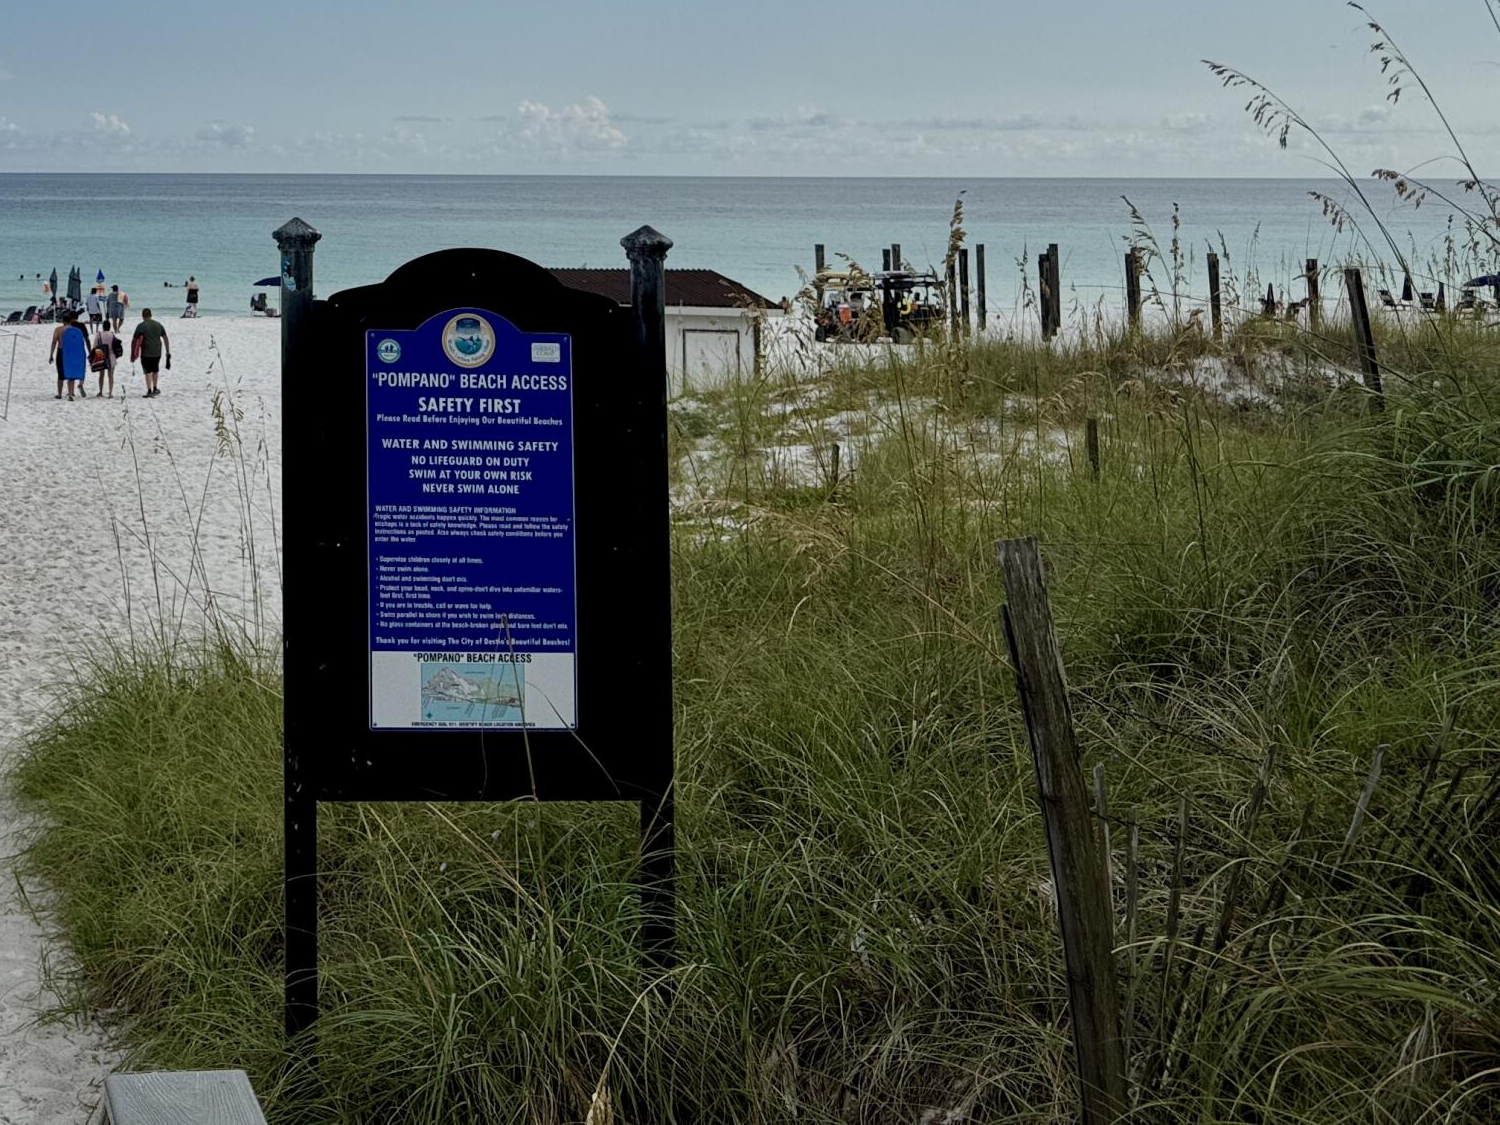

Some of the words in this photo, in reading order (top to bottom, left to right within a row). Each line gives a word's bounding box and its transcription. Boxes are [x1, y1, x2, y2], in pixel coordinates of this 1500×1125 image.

[373, 372, 455, 388] "POMPANO"
[460, 374, 507, 389] BEACH
[511, 375, 567, 390] ACCESS
[418, 397, 473, 412] SAFETY
[480, 398, 521, 413] FIRST
[377, 414, 401, 423] Please
[403, 414, 421, 423] Read
[423, 415, 447, 424] Before
[449, 416, 480, 426] Enjoying
[482, 416, 495, 424] Our
[497, 416, 532, 425] Beautiful
[534, 417, 563, 426] Beaches
[382, 438, 420, 449] WATER
[423, 439, 448, 450] AND
[451, 439, 514, 451] SWIMMING
[518, 441, 558, 452] SAFETY
[411, 455, 426, 465] NO
[429, 456, 483, 466] LIFEGUARD
[486, 457, 501, 466] ON
[503, 457, 530, 467] DUTY
[409, 469, 436, 479] SWIM
[439, 470, 451, 479] AT
[454, 470, 481, 480] YOUR
[483, 471, 507, 480] OWN
[510, 471, 532, 481] RISK
[422, 483, 455, 493] NEVER
[457, 484, 485, 494] SWIM
[487, 485, 520, 494] ALONE
[422, 637, 446, 646] visiting
[461, 638, 474, 646] City
[467, 654, 495, 662] BEACH
[498, 654, 532, 663] ACCESS
